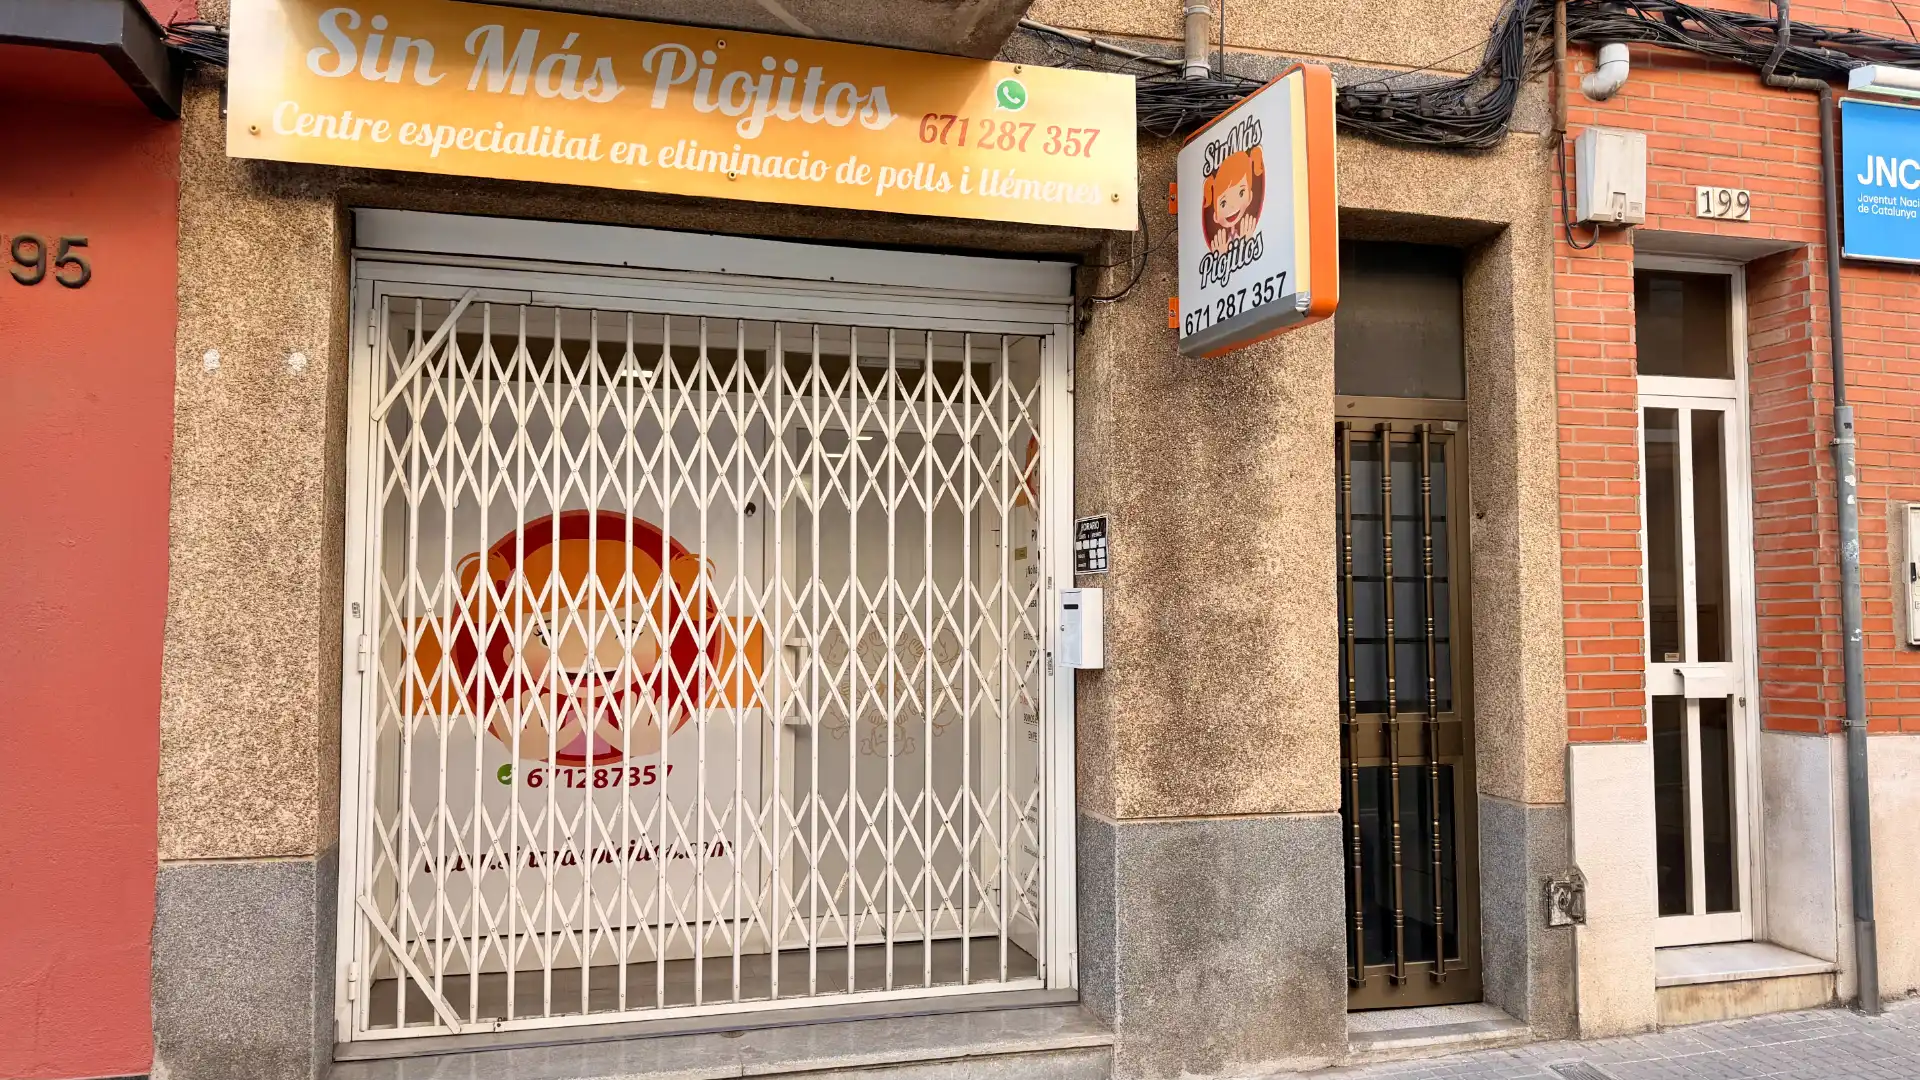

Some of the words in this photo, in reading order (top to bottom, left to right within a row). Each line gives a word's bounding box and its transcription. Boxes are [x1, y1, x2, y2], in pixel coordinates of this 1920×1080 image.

[306, 8, 446, 87] Sin
[464, 24, 625, 103] Más
[642, 42, 898, 140] Piojitos
[272, 101, 391, 144] Centre
[399, 122, 604, 161] especialitat
[610, 140, 650, 167] en
[658, 136, 831, 182] eliminacio
[835, 155, 872, 186] de
[875, 163, 954, 196] polls
[960, 165, 973, 195] i
[979, 167, 1101, 206] llémenes
[919, 112, 969, 148] 671
[977, 118, 1036, 153] 287
[1043, 125, 1101, 158] 357
[1857, 155, 1920, 191] JNC
[1700, 189, 1750, 219] 199
[1857, 204, 1869, 214] de
[1871, 204, 1917, 219] Catalunya
[0, 232, 92, 289] 95
[1199, 231, 1264, 290] Piojitos
[1185, 304, 1211, 336] 671
[1216, 288, 1247, 323] 287
[1252, 271, 1288, 308] 357
